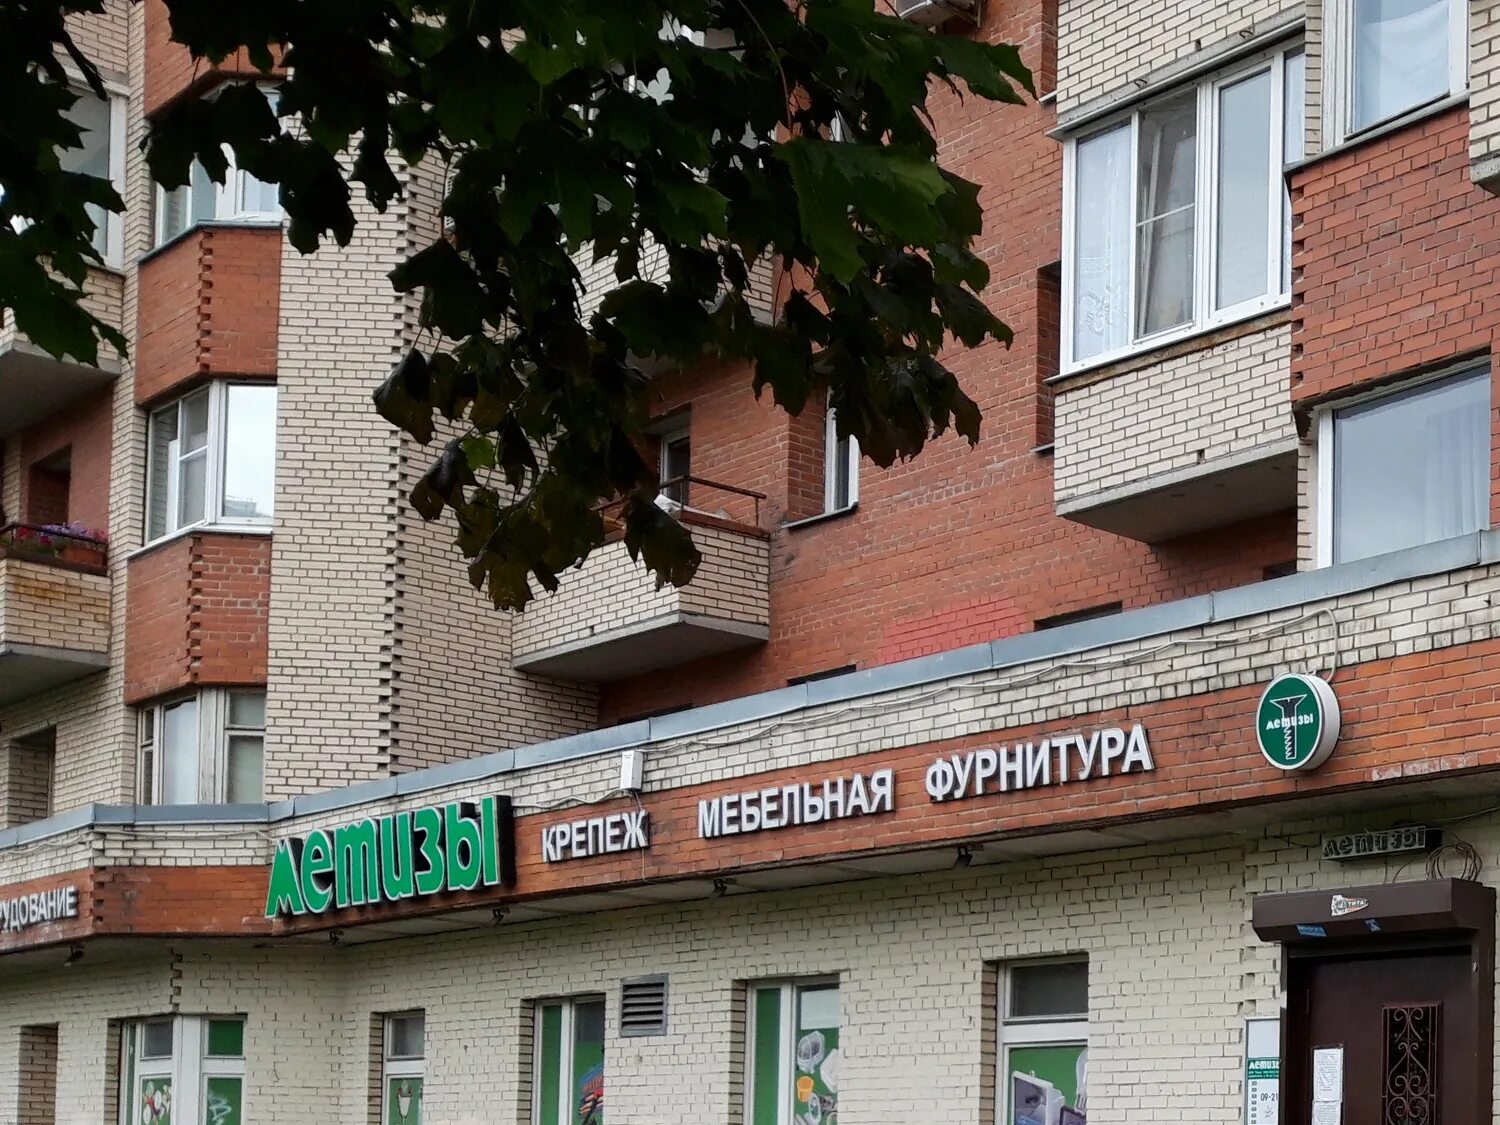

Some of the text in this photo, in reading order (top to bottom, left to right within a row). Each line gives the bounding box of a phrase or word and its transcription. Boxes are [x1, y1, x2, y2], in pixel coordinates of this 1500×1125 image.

[541, 723, 1155, 862] КРЕПЕЖ МЕБЕЛЬНАЯ ФУРНИТУРА
[0, 885, 78, 934] УДОВАНИЕ
